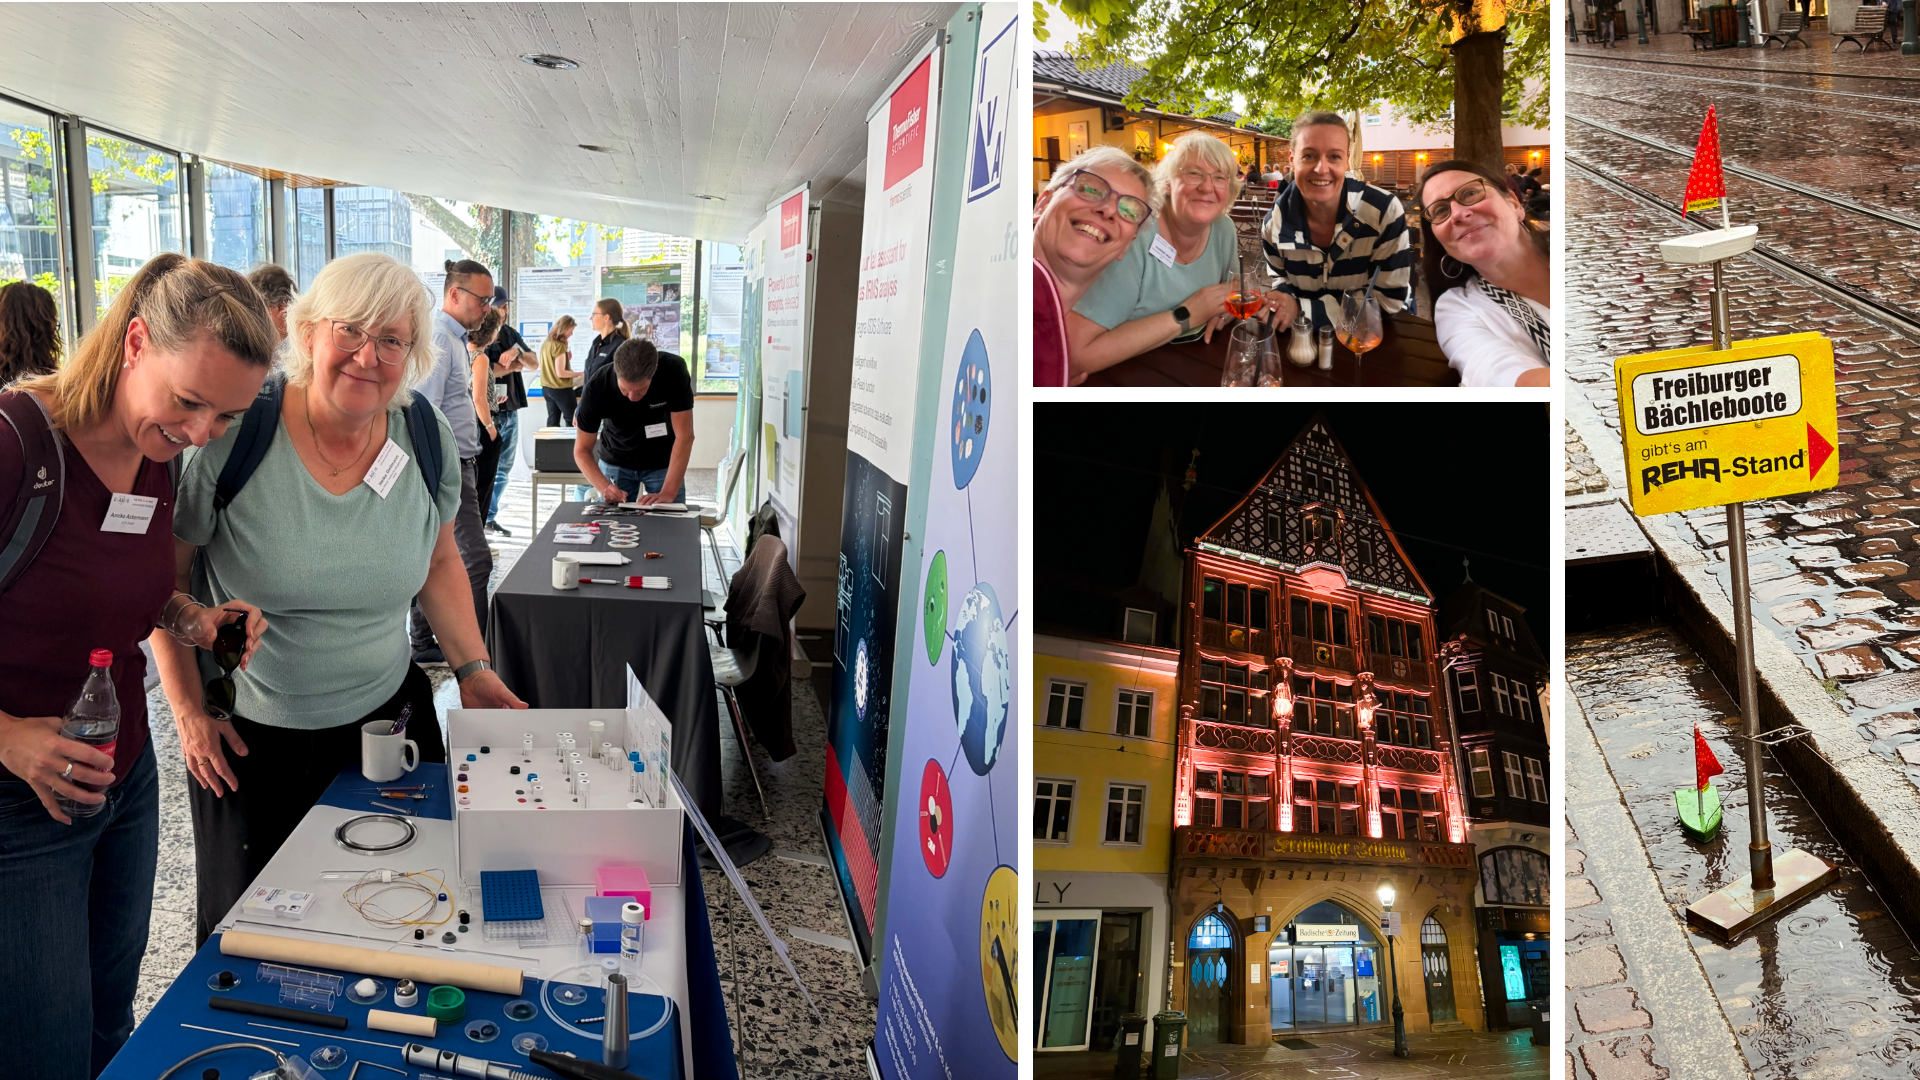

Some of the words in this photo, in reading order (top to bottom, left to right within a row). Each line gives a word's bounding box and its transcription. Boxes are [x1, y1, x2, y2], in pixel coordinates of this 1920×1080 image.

[892, 106, 921, 143] ThermoFisher
[891, 124, 920, 156] SCIENTIFIC
[1652, 366, 1772, 401] Freiburger
[1644, 391, 1787, 430] Bächleboote
[1685, 438, 1708, 451] am
[33, 479, 56, 490] deuter
[1035, 882, 1072, 903] LY
[1514, 912, 1547, 921] RITUALS
[1299, 928, 1325, 937] Badische
[1334, 928, 1357, 939] Zeitung
